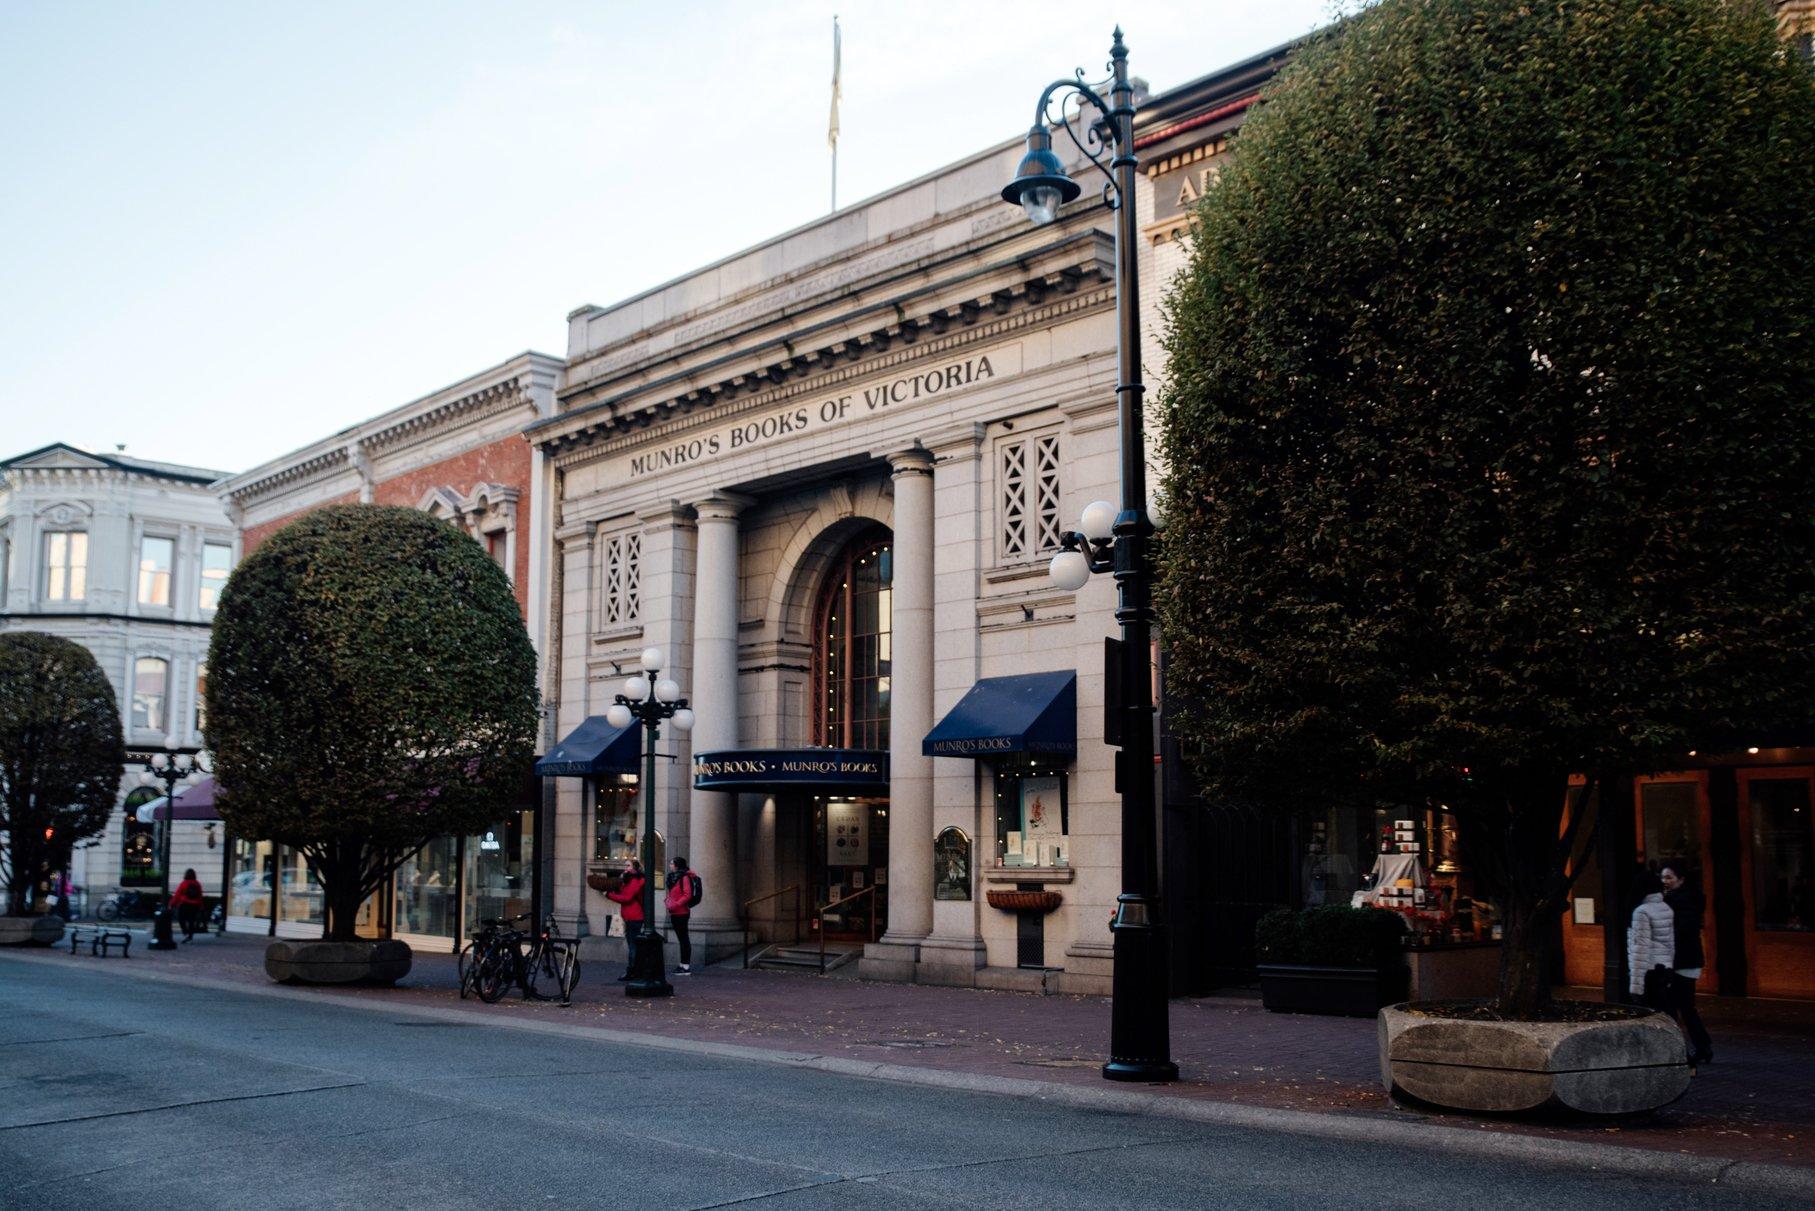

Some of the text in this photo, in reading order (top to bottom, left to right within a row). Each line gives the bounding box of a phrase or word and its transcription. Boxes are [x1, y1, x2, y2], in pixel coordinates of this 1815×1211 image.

[630, 355, 995, 477] MUNRO'S BOOKS OF VICTORIA
[933, 737, 1012, 753] MUNRO'S BOOKS
[724, 760, 766, 774] BOOKS
[782, 761, 878, 774] MUNRO'S BOOKS
